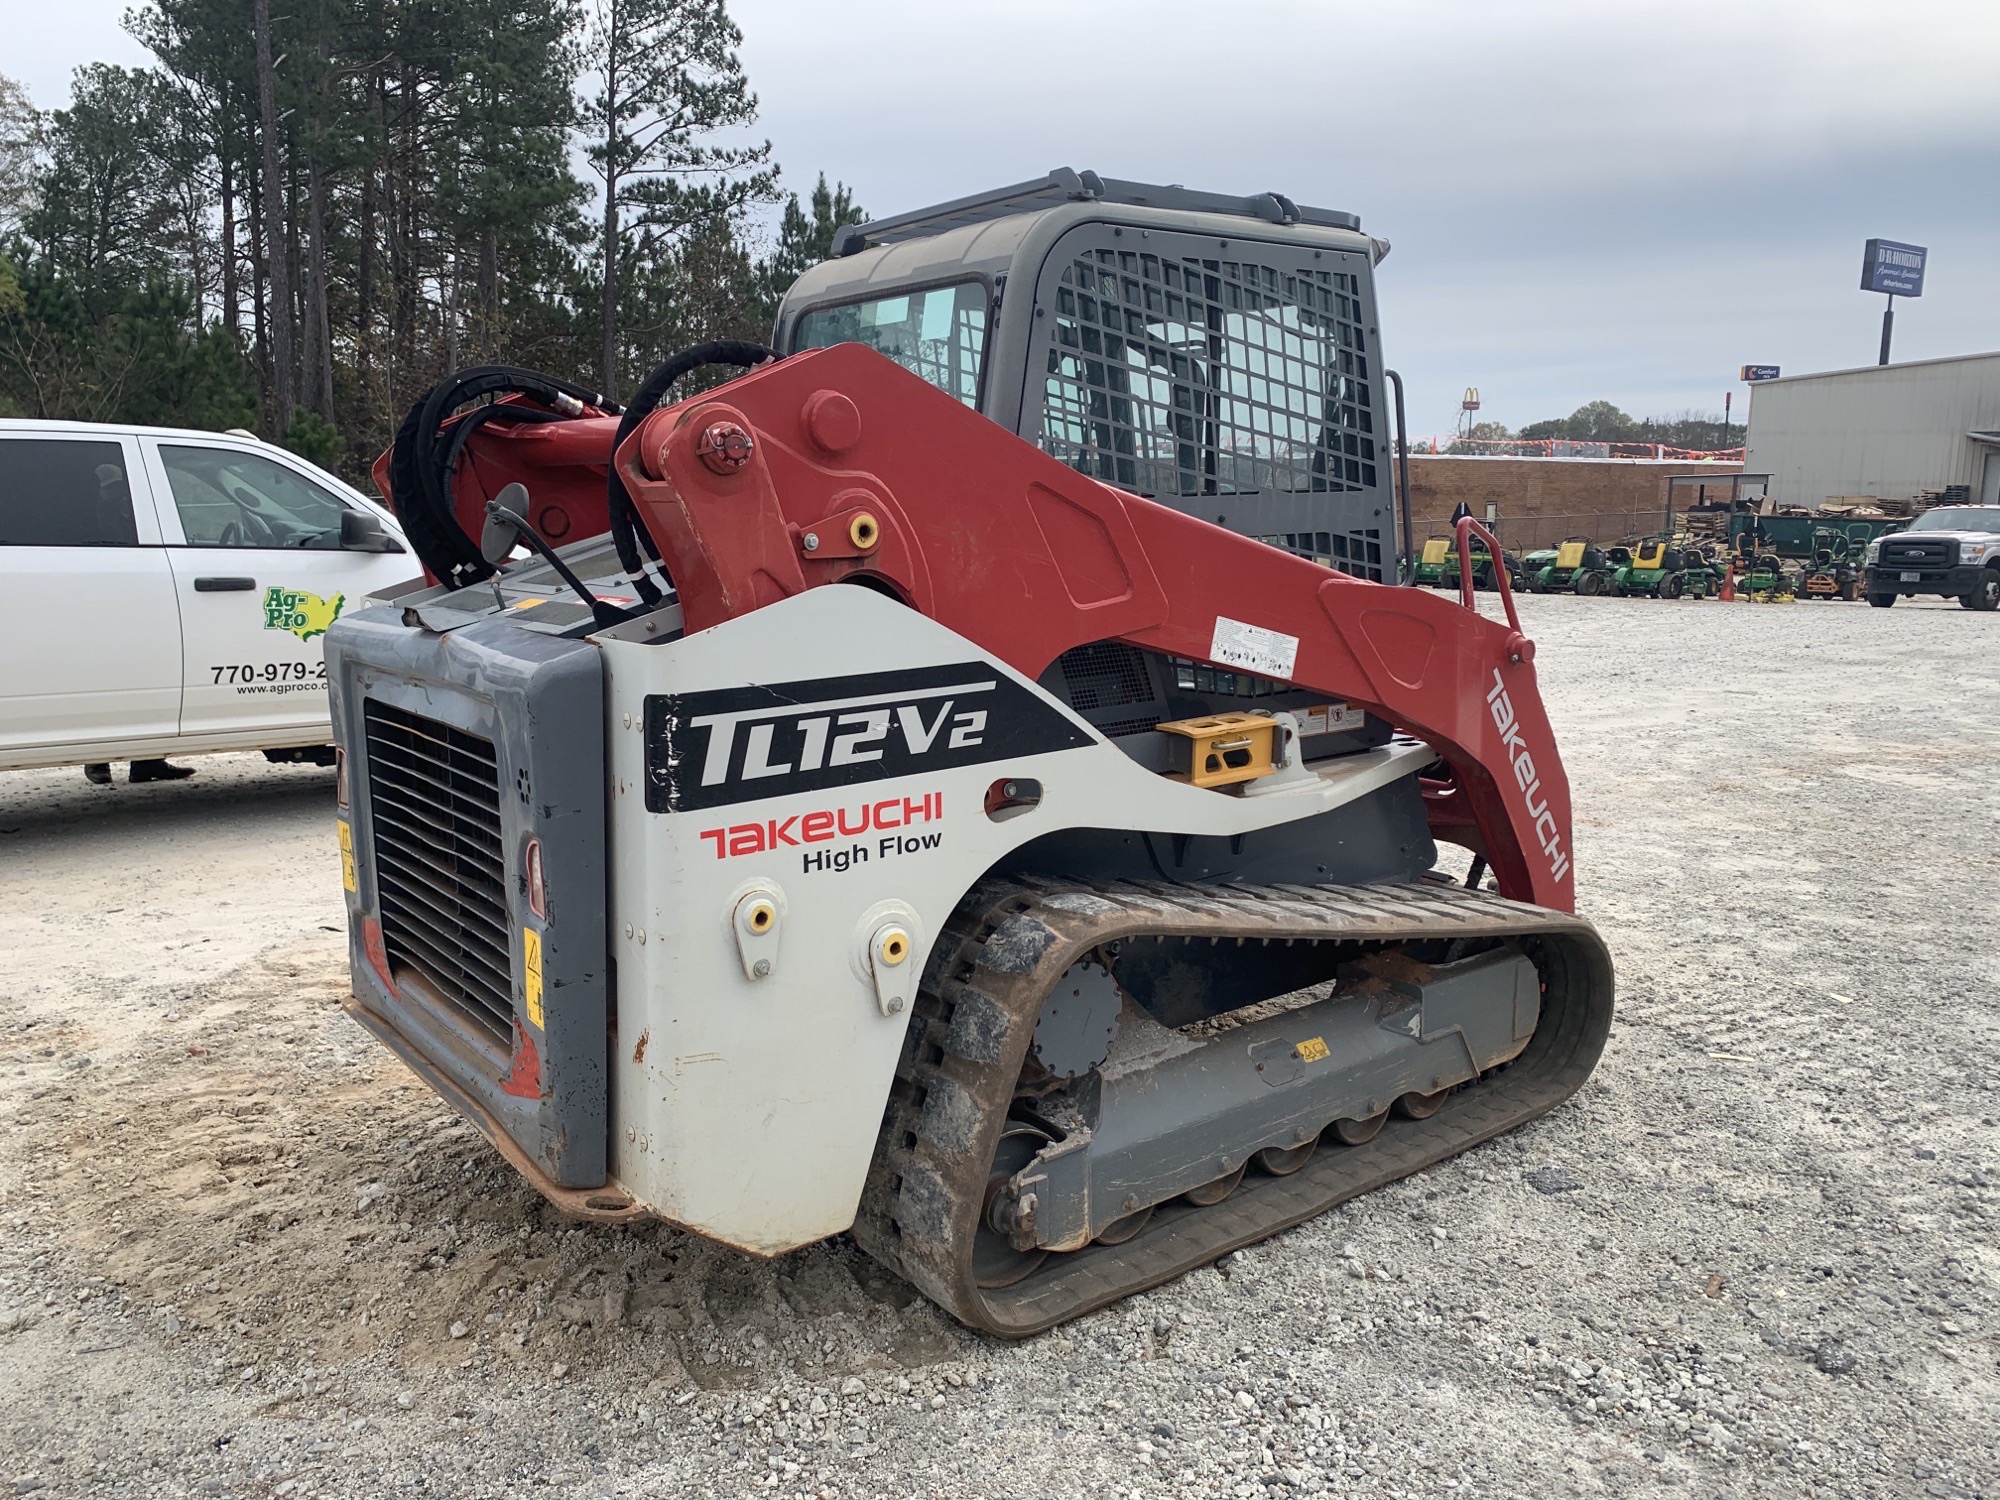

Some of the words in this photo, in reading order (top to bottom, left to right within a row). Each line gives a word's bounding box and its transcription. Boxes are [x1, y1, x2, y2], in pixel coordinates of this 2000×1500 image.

[265, 587, 307, 612] Ag-
[265, 608, 308, 629] Pro
[802, 843, 869, 874] High
[878, 832, 943, 860] Flow
